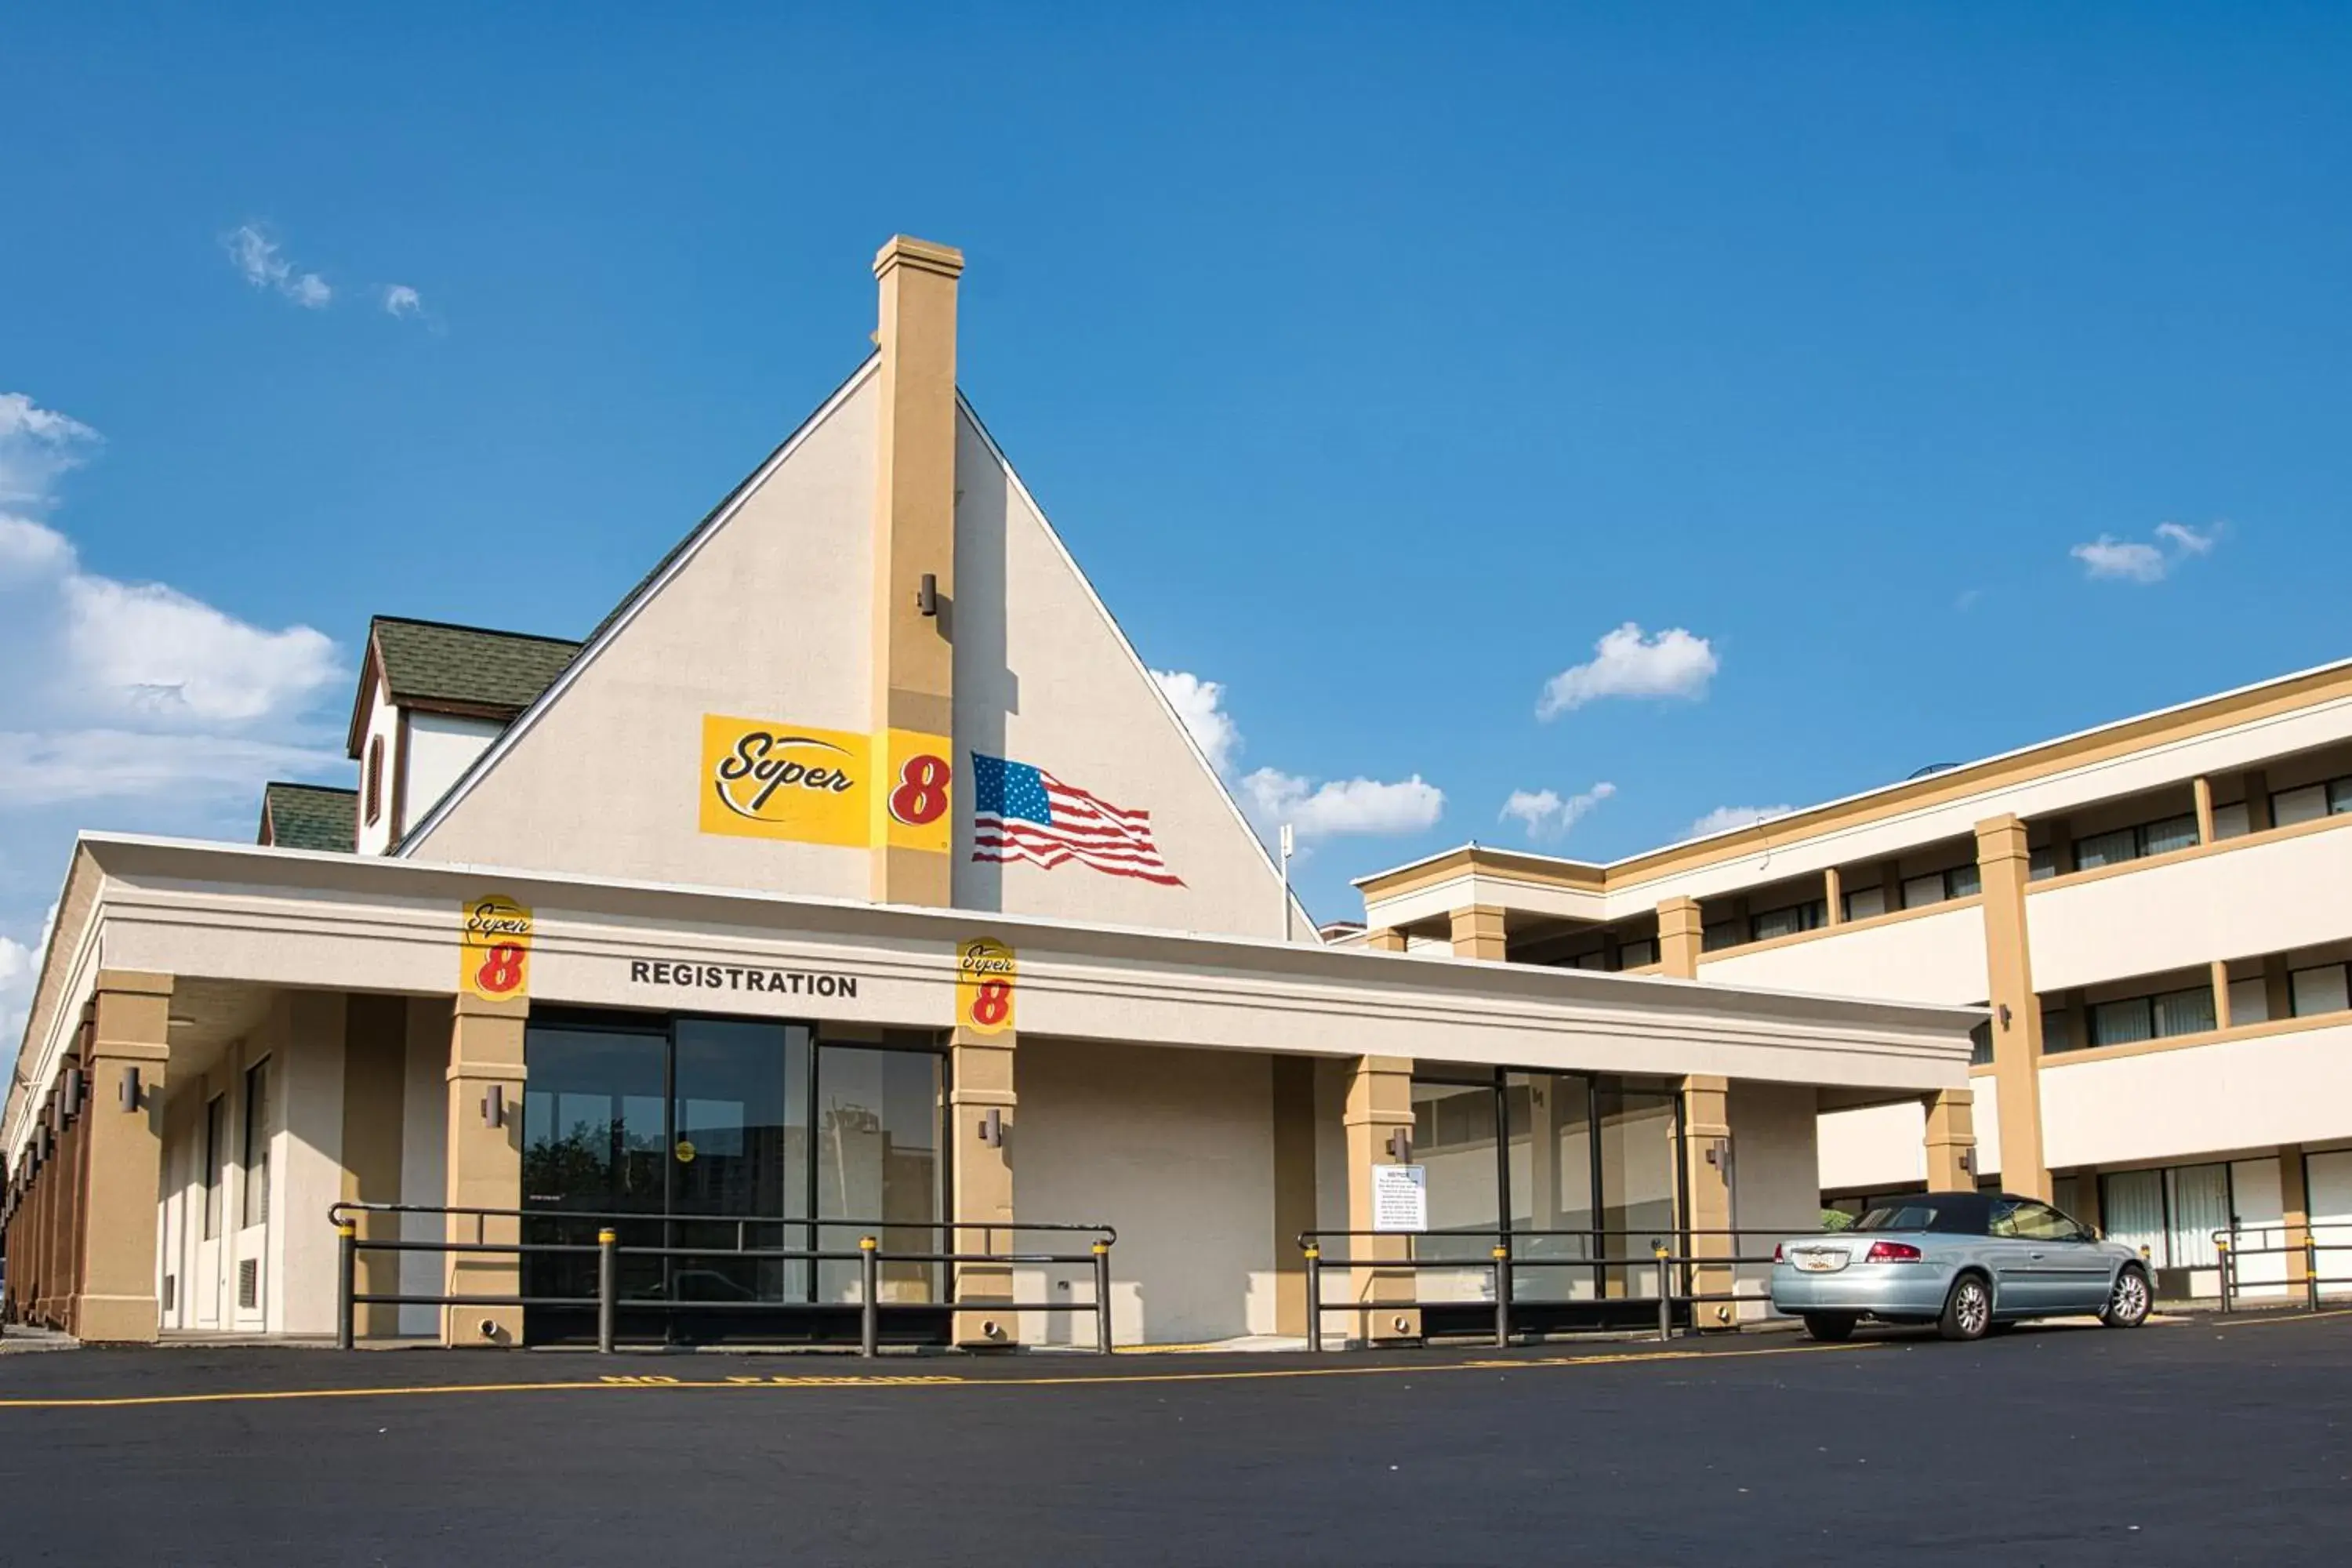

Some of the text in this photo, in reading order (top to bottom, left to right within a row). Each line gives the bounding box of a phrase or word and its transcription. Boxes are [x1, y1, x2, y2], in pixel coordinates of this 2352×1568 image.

[717, 731, 951, 826] Super 8
[466, 902, 531, 939] Super
[475, 942, 526, 993] 8
[631, 960, 858, 998] REGISTRATION
[961, 943, 1014, 978] Super
[969, 978, 1011, 1025] 8
